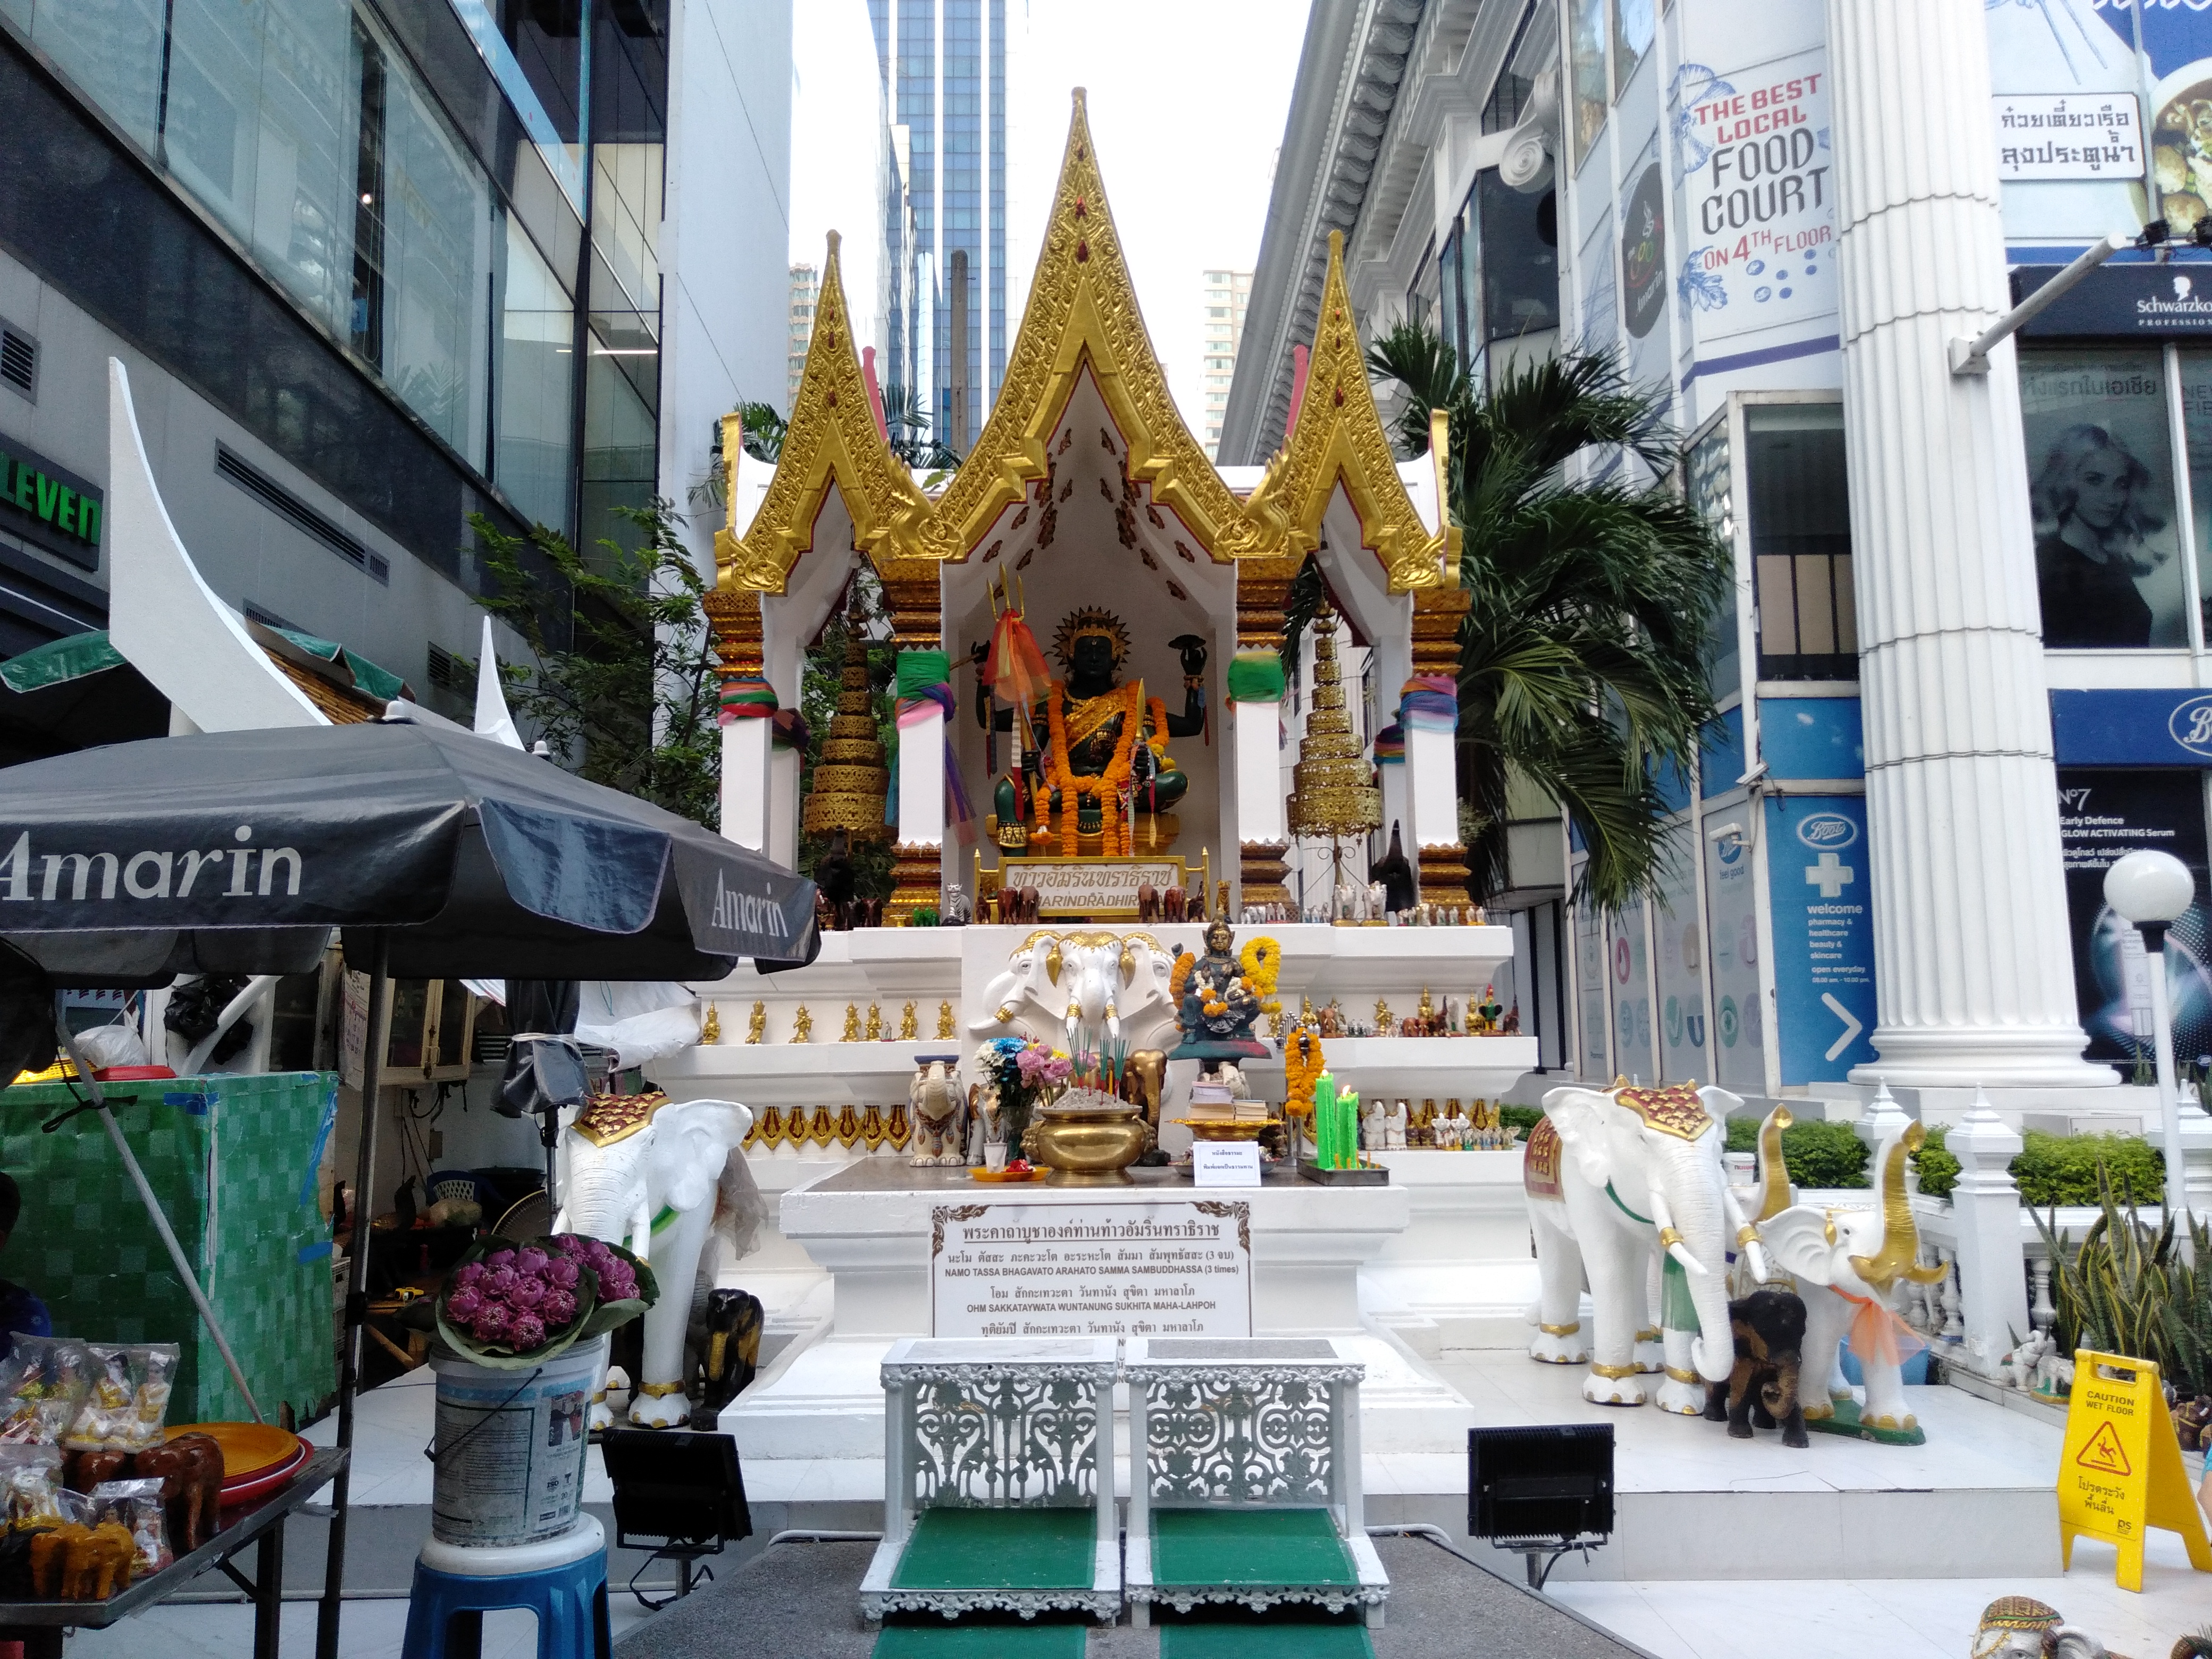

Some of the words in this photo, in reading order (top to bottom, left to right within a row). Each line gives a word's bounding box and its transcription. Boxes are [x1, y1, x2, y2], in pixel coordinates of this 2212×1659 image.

[1694, 95, 1745, 125] THE
[1752, 73, 1822, 110] BEST
[2001, 99, 2129, 128] ก๋วยเตี๋ยวเรือ
[1717, 105, 1806, 144] LOCAL
[1712, 128, 1814, 190] FOOD
[2001, 130, 2135, 172] ลุงประตูน้ำ
[1701, 165, 1829, 235] COURT
[1704, 248, 1728, 270] ON
[1732, 229, 1771, 262] 4TH
[1774, 225, 1831, 254] FLOOR
[1807, 822, 1846, 840] Boots
[2059, 816, 2083, 826] Early
[2085, 815, 2124, 825] Defence
[2090, 828, 2145, 837] ACTIVATING
[0, 825, 302, 901] Amarin
[711, 868, 789, 937] Amarin
[1807, 903, 1863, 914] welcome
[963, 1218, 1219, 1244] พระคาถาบูชาองค์ท่านท้าวอัมรินทราธิราช
[948, 1251, 971, 1263] นะโม
[978, 1251, 1004, 1263] ตัสสะ
[1010, 1249, 1058, 1262] ภะคะวะโต
[1064, 1248, 1111, 1262] อะระหะโต
[1117, 1249, 1143, 1261] สัมมา
[1149, 1247, 1203, 1263] สัมพุทธัสสะ
[1205, 1250, 1214, 1261] (3
[1218, 1250, 1234, 1261] จบ)
[973, 1268, 1000, 1277] TASSA
[1002, 1267, 1054, 1276] BHAGAVATO
[1055, 1267, 1096, 1275] ARAHATO
[1099, 1266, 1129, 1275] SAMMA
[1132, 1265, 1203, 1274] SAMBUDDHASSA
[1204, 1265, 1212, 1275] (3
[1214, 1264, 1239, 1274] times)
[990, 1286, 1008, 1298] โอม
[1015, 1286, 1073, 1298] สักกะเทวะตา
[1079, 1285, 1117, 1297] วันทานัง
[1123, 1285, 1147, 1300] สุขิตา
[1154, 1283, 1195, 1296] มหาลาโภ
[967, 1304, 986, 1312] OHM
[988, 1303, 1055, 1312] SAKKATAYWATA
[1058, 1302, 1113, 1311] WUNTANUNG
[1115, 1301, 1151, 1310] SUKHITA
[1153, 1301, 1216, 1310] MAHA-LAHPOH
[1023, 1322, 1080, 1335] สักกะเทวะตา
[1087, 1321, 1125, 1334] วันทานัง
[1132, 1320, 1156, 1336] สุขิตา
[1162, 1319, 1203, 1332] มหาลาโภ
[2086, 1400, 2103, 1410] WET
[2106, 1404, 2133, 1417] FLOOR
[2087, 1390, 2134, 1406] CAUTION
[2078, 1476, 2125, 1500] โปรดระวัง
[2084, 1493, 2115, 1514] พื้นลื่น
